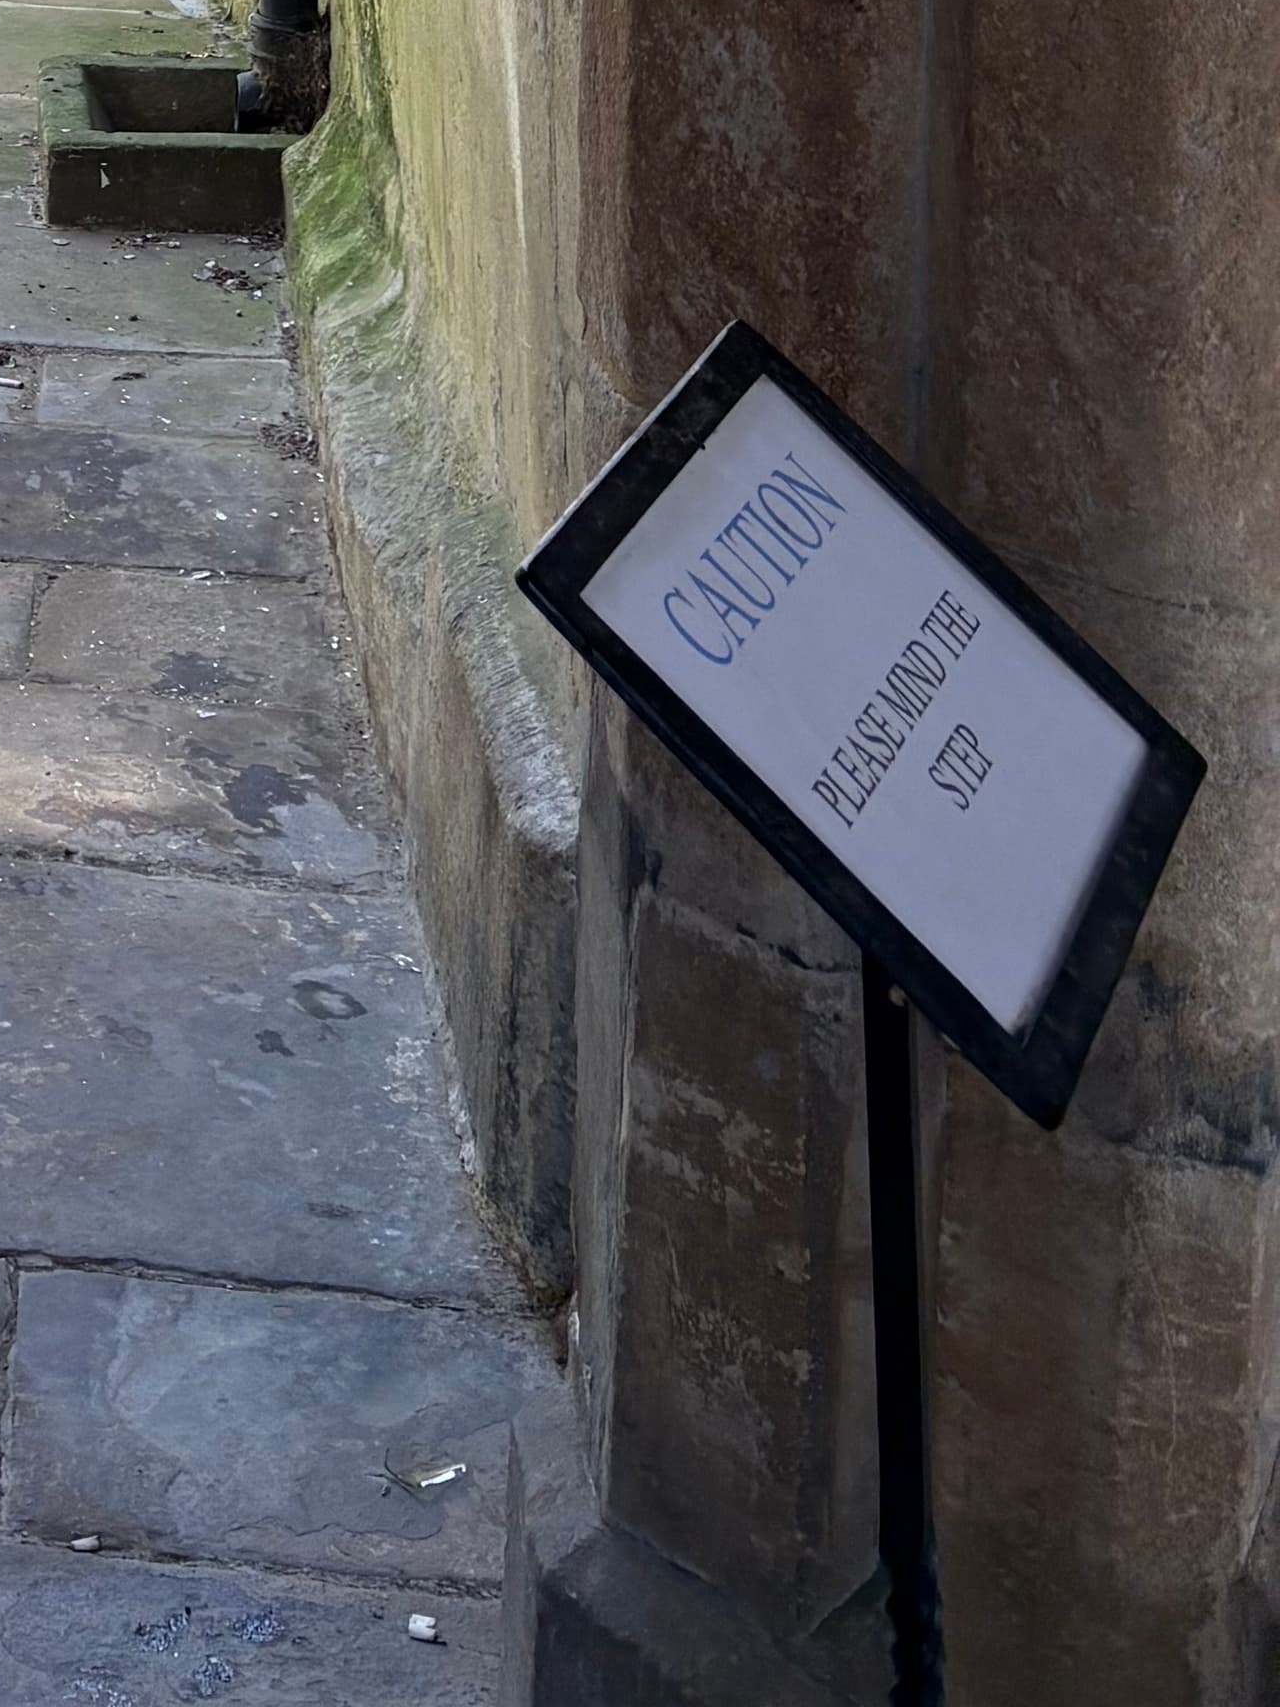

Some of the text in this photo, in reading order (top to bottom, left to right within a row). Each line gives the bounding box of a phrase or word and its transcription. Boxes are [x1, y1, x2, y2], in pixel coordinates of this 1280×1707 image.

[663, 451, 848, 665] CAUTION
[811, 589, 981, 829] PLEASE MIND THE
[928, 723, 993, 813] STEP
